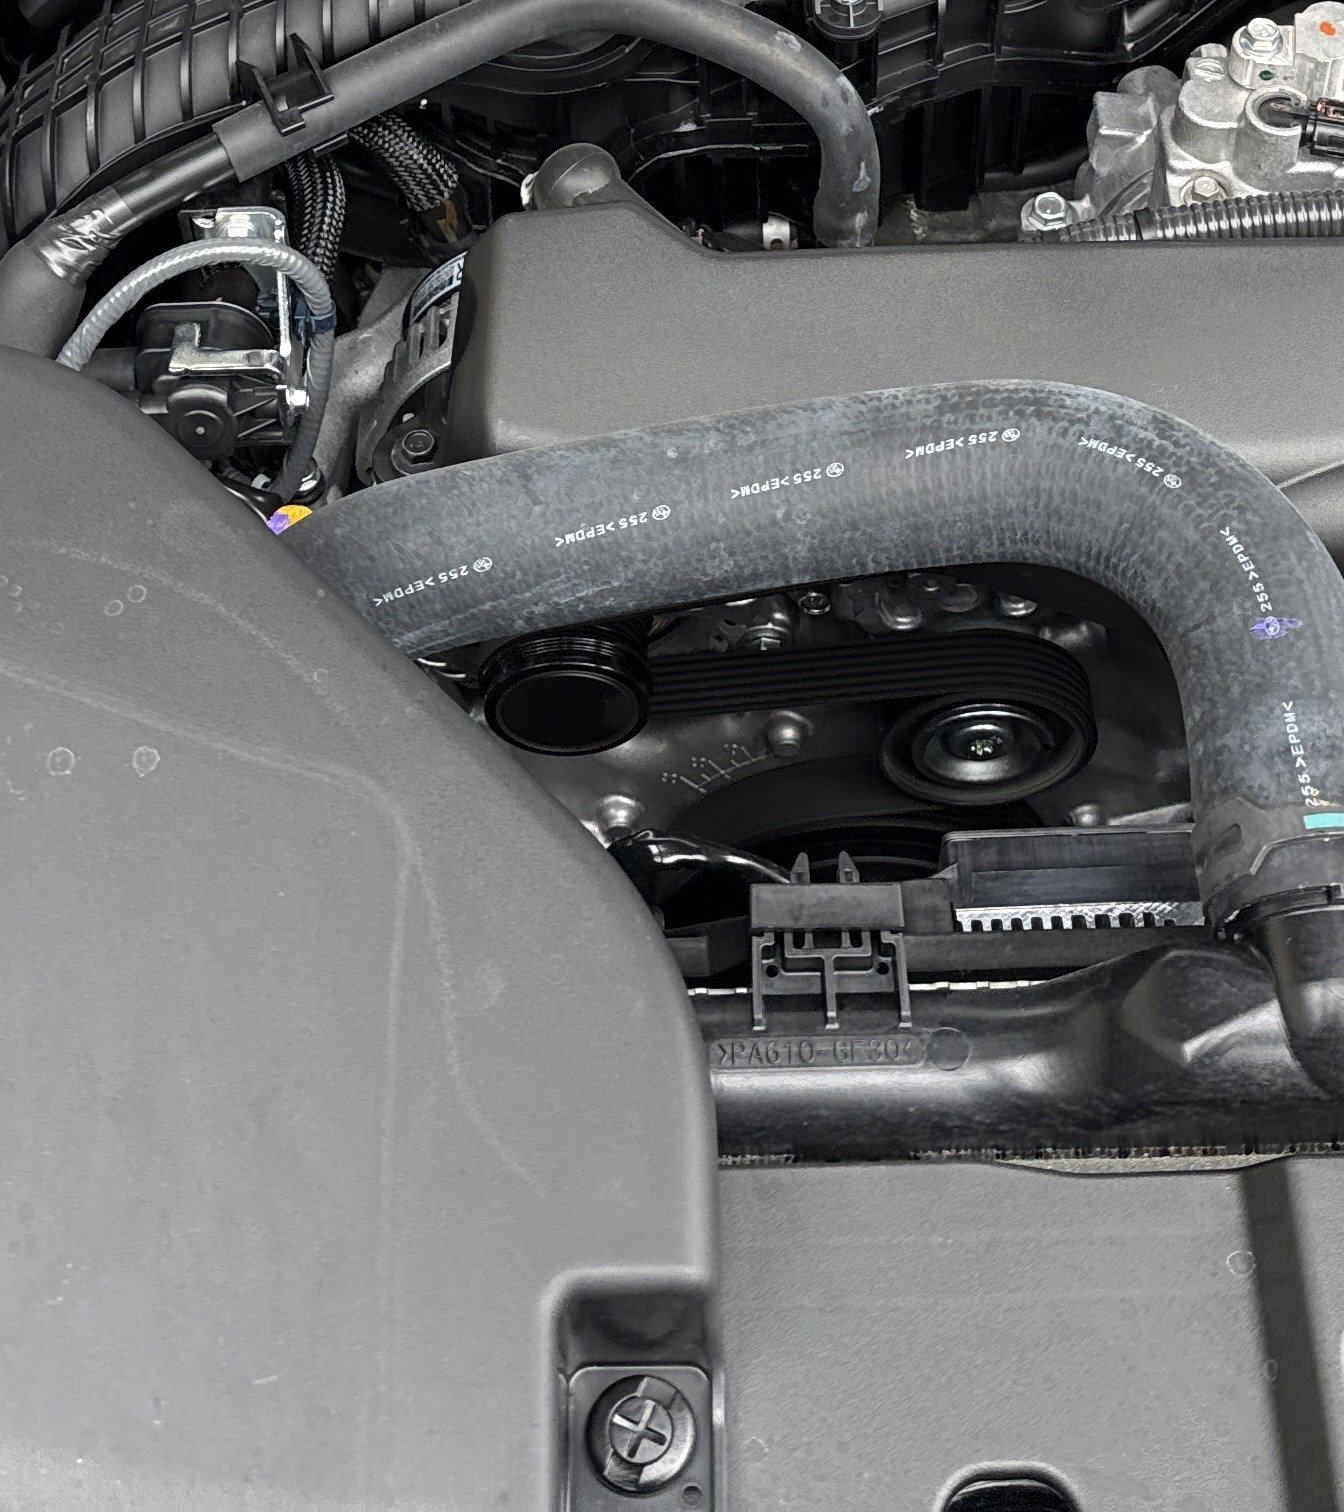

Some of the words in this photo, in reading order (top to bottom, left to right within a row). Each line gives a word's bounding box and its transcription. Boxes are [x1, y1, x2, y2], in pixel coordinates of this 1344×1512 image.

[967, 430, 998, 446] 255
[1134, 454, 1166, 478] 255
[792, 467, 822, 484] 255
[618, 512, 649, 530] 255
[438, 565, 470, 586] 255
